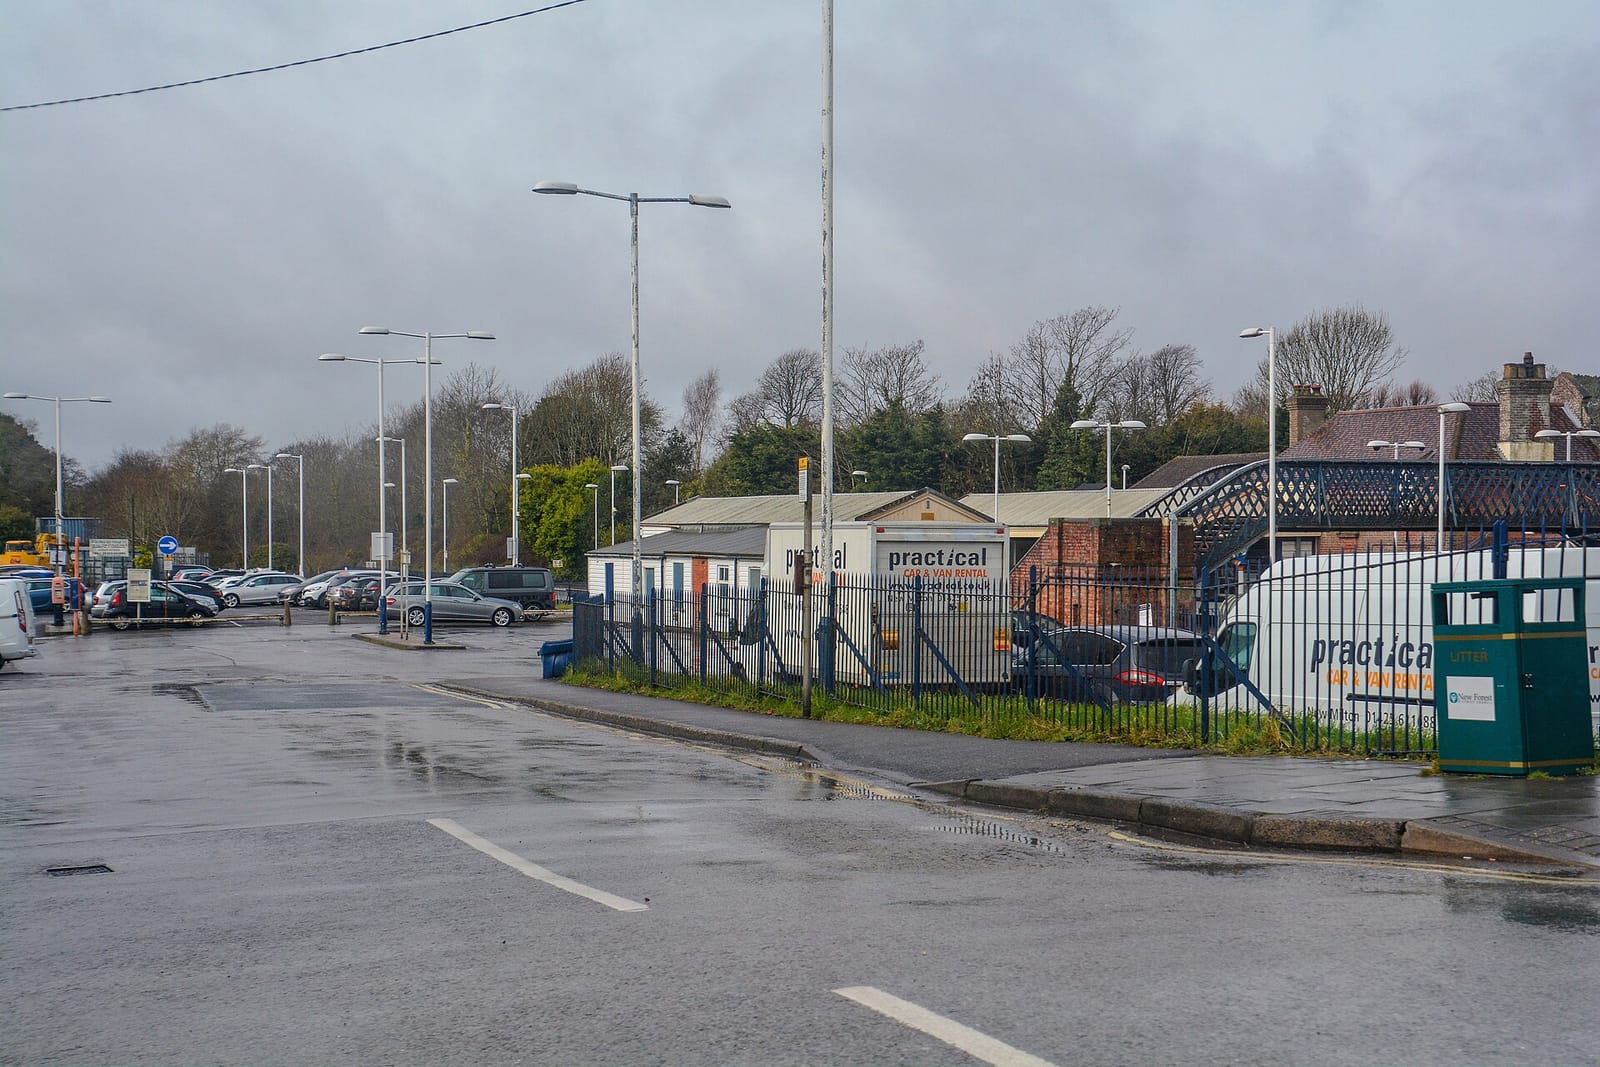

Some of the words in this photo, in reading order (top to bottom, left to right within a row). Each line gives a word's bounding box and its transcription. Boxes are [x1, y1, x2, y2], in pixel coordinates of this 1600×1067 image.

[889, 547, 987, 571] practical
[903, 569, 921, 578] CAR
[923, 569, 929, 578] &
[933, 569, 952, 578] VAN
[955, 569, 988, 578] RENTAL
[1311, 633, 1433, 673] practica
[1450, 651, 1488, 663] LITTER
[1326, 669, 1348, 686] CAR
[1363, 672, 1390, 689] VAN
[1474, 692, 1492, 701] Forest
[1329, 708, 1360, 722] Mton
